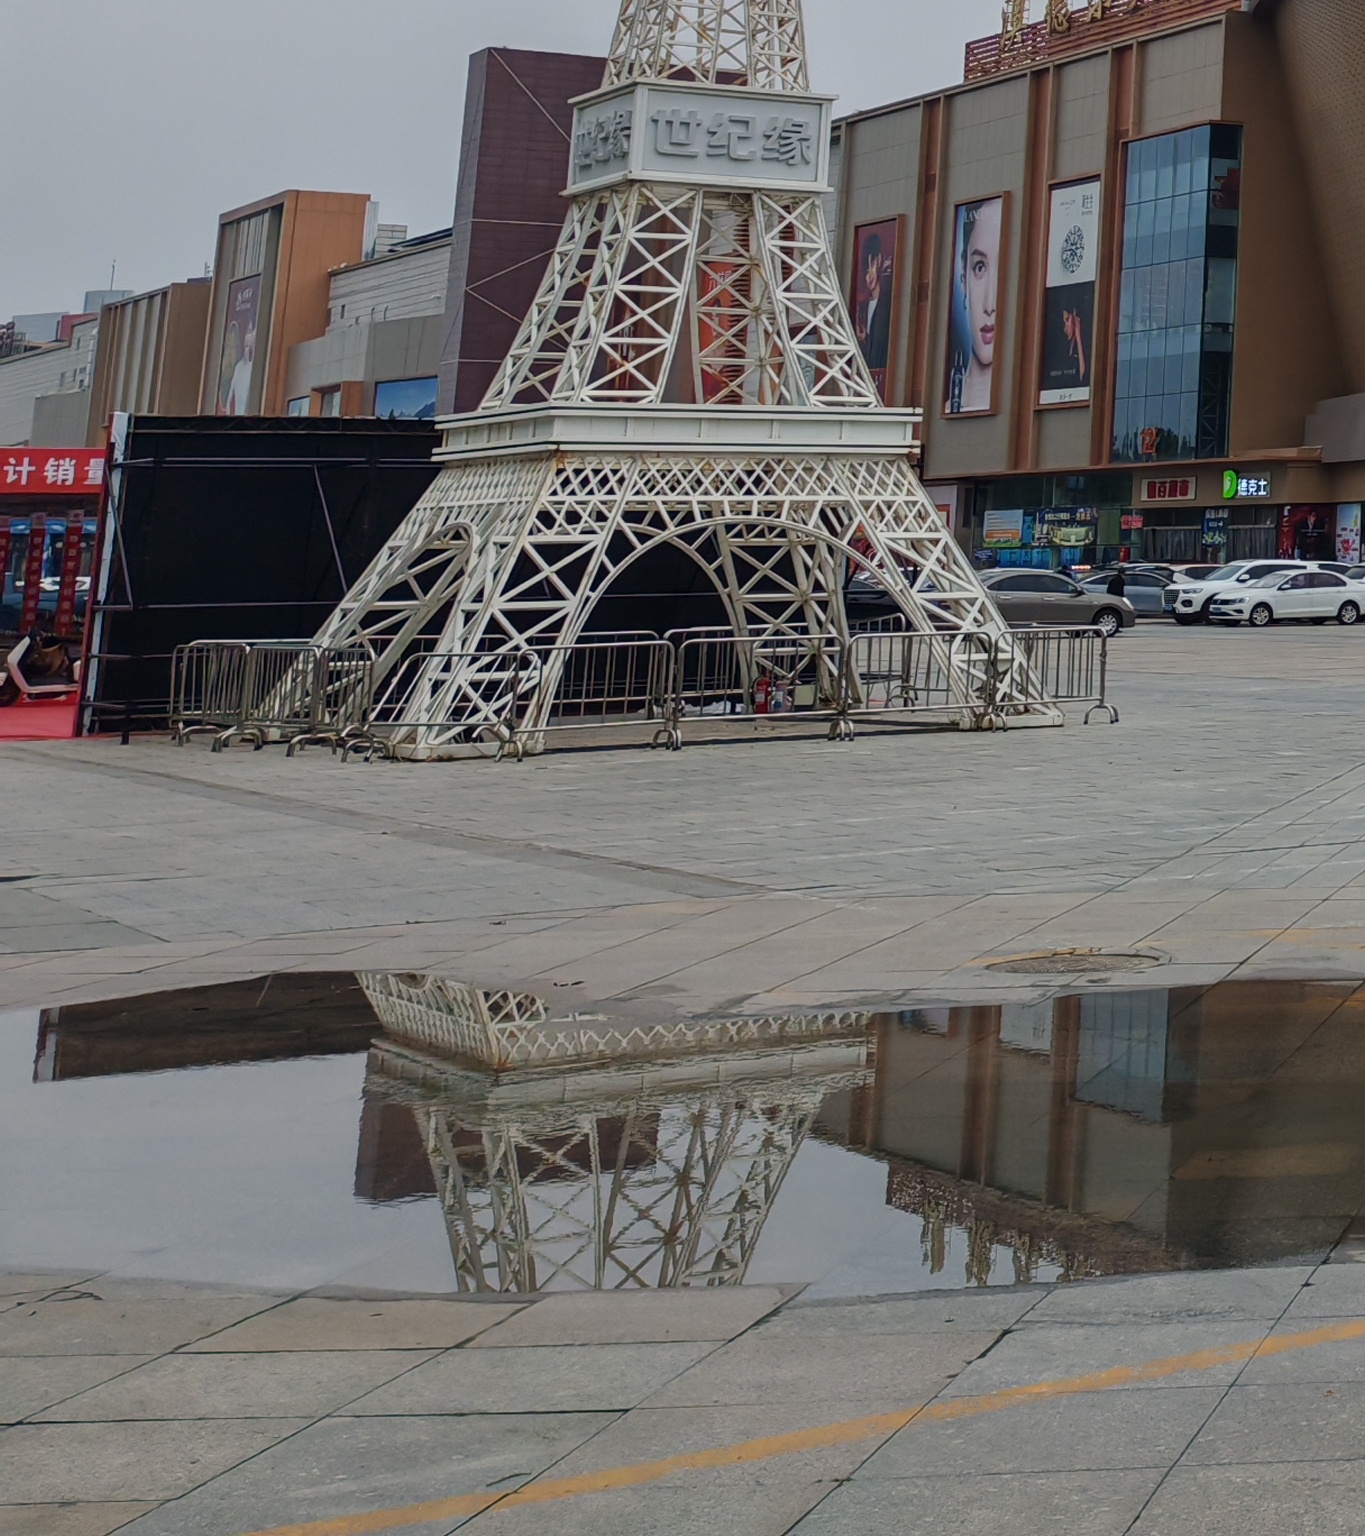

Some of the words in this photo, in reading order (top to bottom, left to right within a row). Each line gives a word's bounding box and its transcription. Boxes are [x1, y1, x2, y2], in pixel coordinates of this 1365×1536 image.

[650, 108, 814, 165] 世纪缘
[1237, 477, 1269, 496] 德克士
